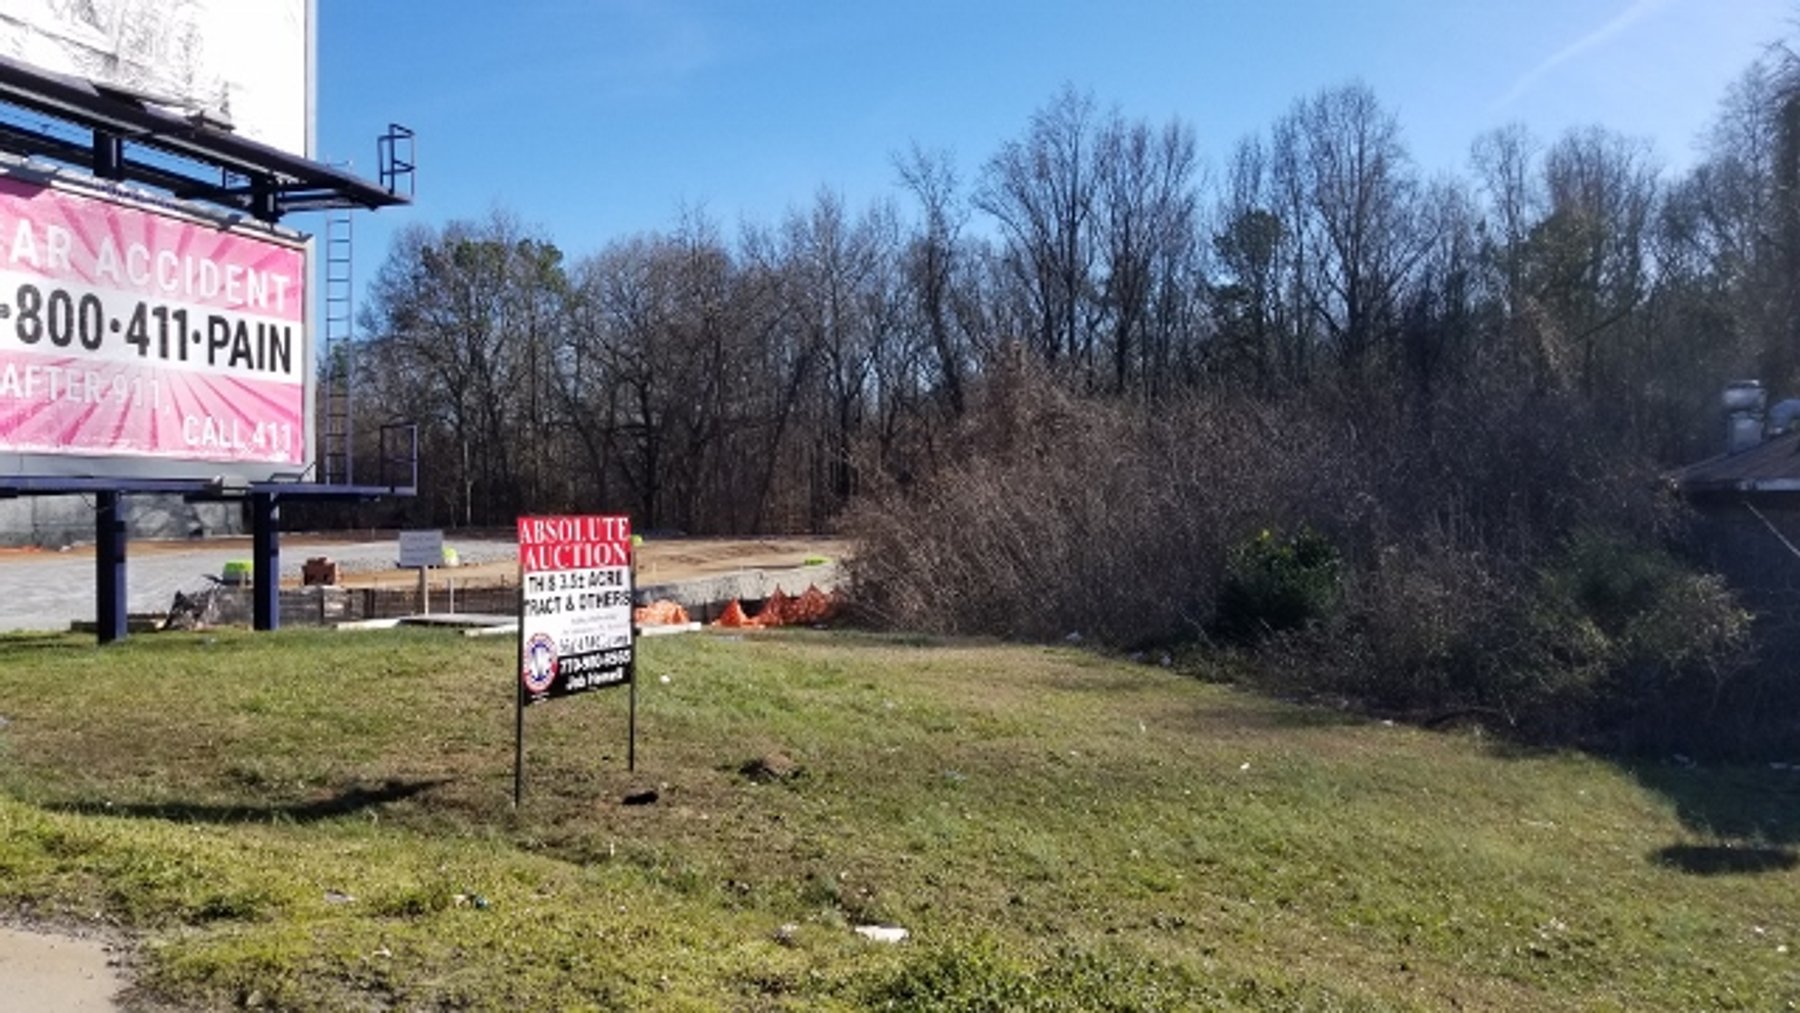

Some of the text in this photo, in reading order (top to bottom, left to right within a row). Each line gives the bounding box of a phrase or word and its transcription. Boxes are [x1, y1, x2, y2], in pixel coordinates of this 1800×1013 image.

[96, 237, 292, 311] ACCIDENT
[1, 363, 102, 404] AFTER
[183, 416, 292, 450] CALL 411
[519, 517, 629, 544] ABSOLUTE
[525, 542, 629, 572] AUCTION
[529, 575, 556, 592] THS
[588, 569, 623, 588] ACRE
[565, 594, 575, 612] &
[579, 590, 631, 611] OTHERS
